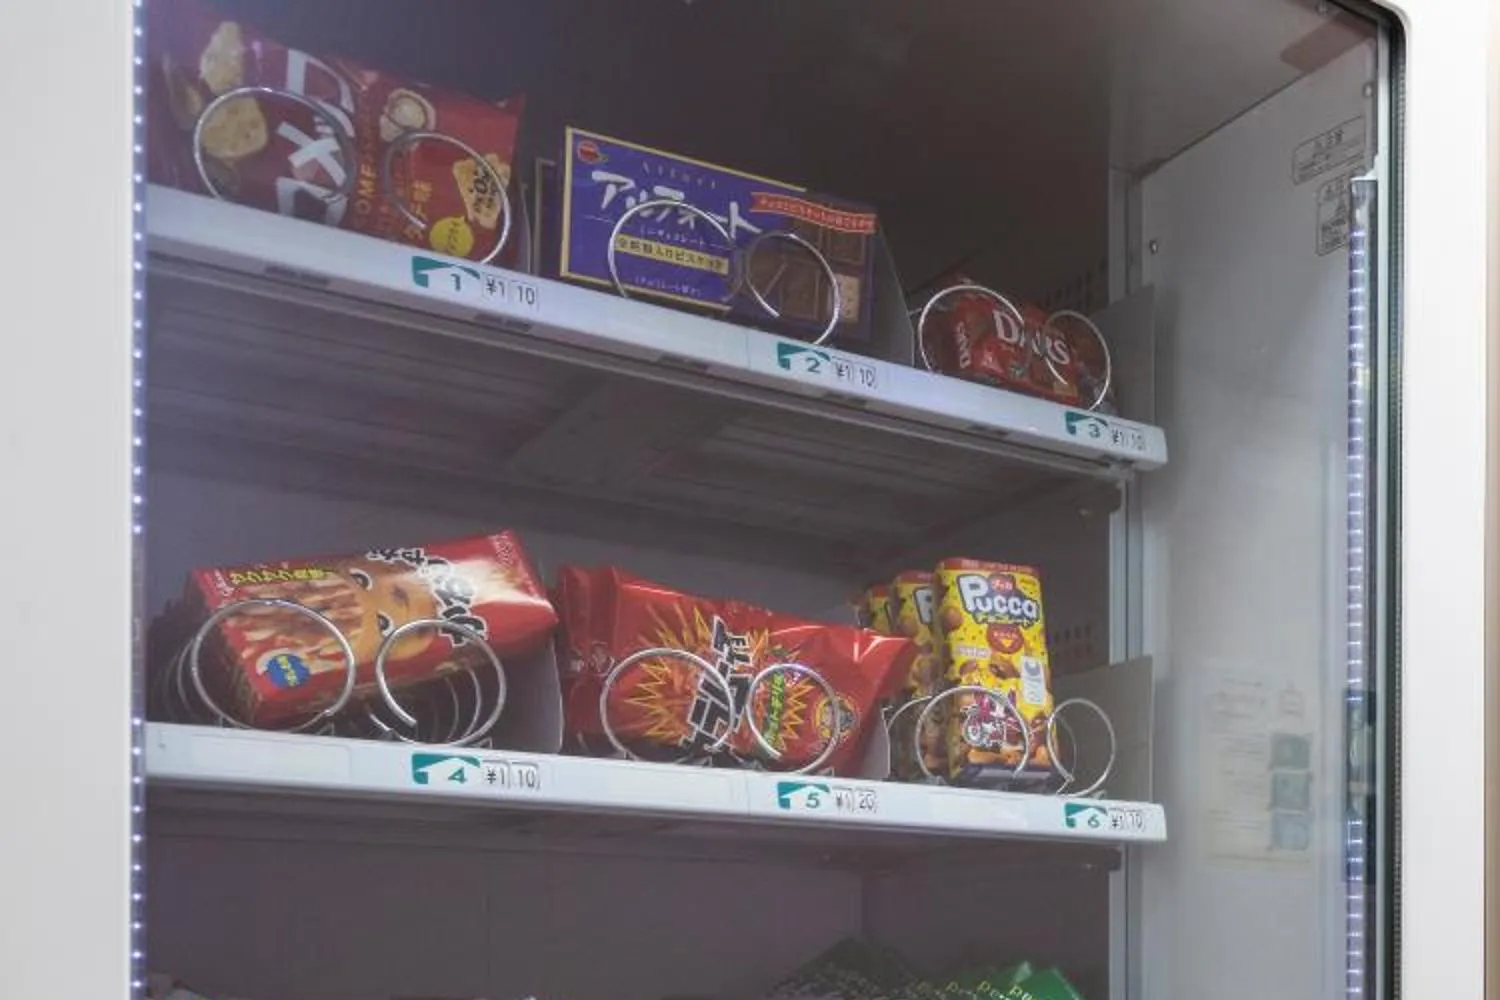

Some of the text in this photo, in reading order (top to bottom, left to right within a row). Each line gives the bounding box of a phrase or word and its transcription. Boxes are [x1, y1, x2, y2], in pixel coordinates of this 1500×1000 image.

[805, 356, 822, 373] 2
[1089, 422, 1101, 438] 3
[958, 575, 1038, 620] Pucca
[448, 766, 468, 785] 4
[805, 793, 821, 809] 5
[1086, 814, 1100, 829] 6
